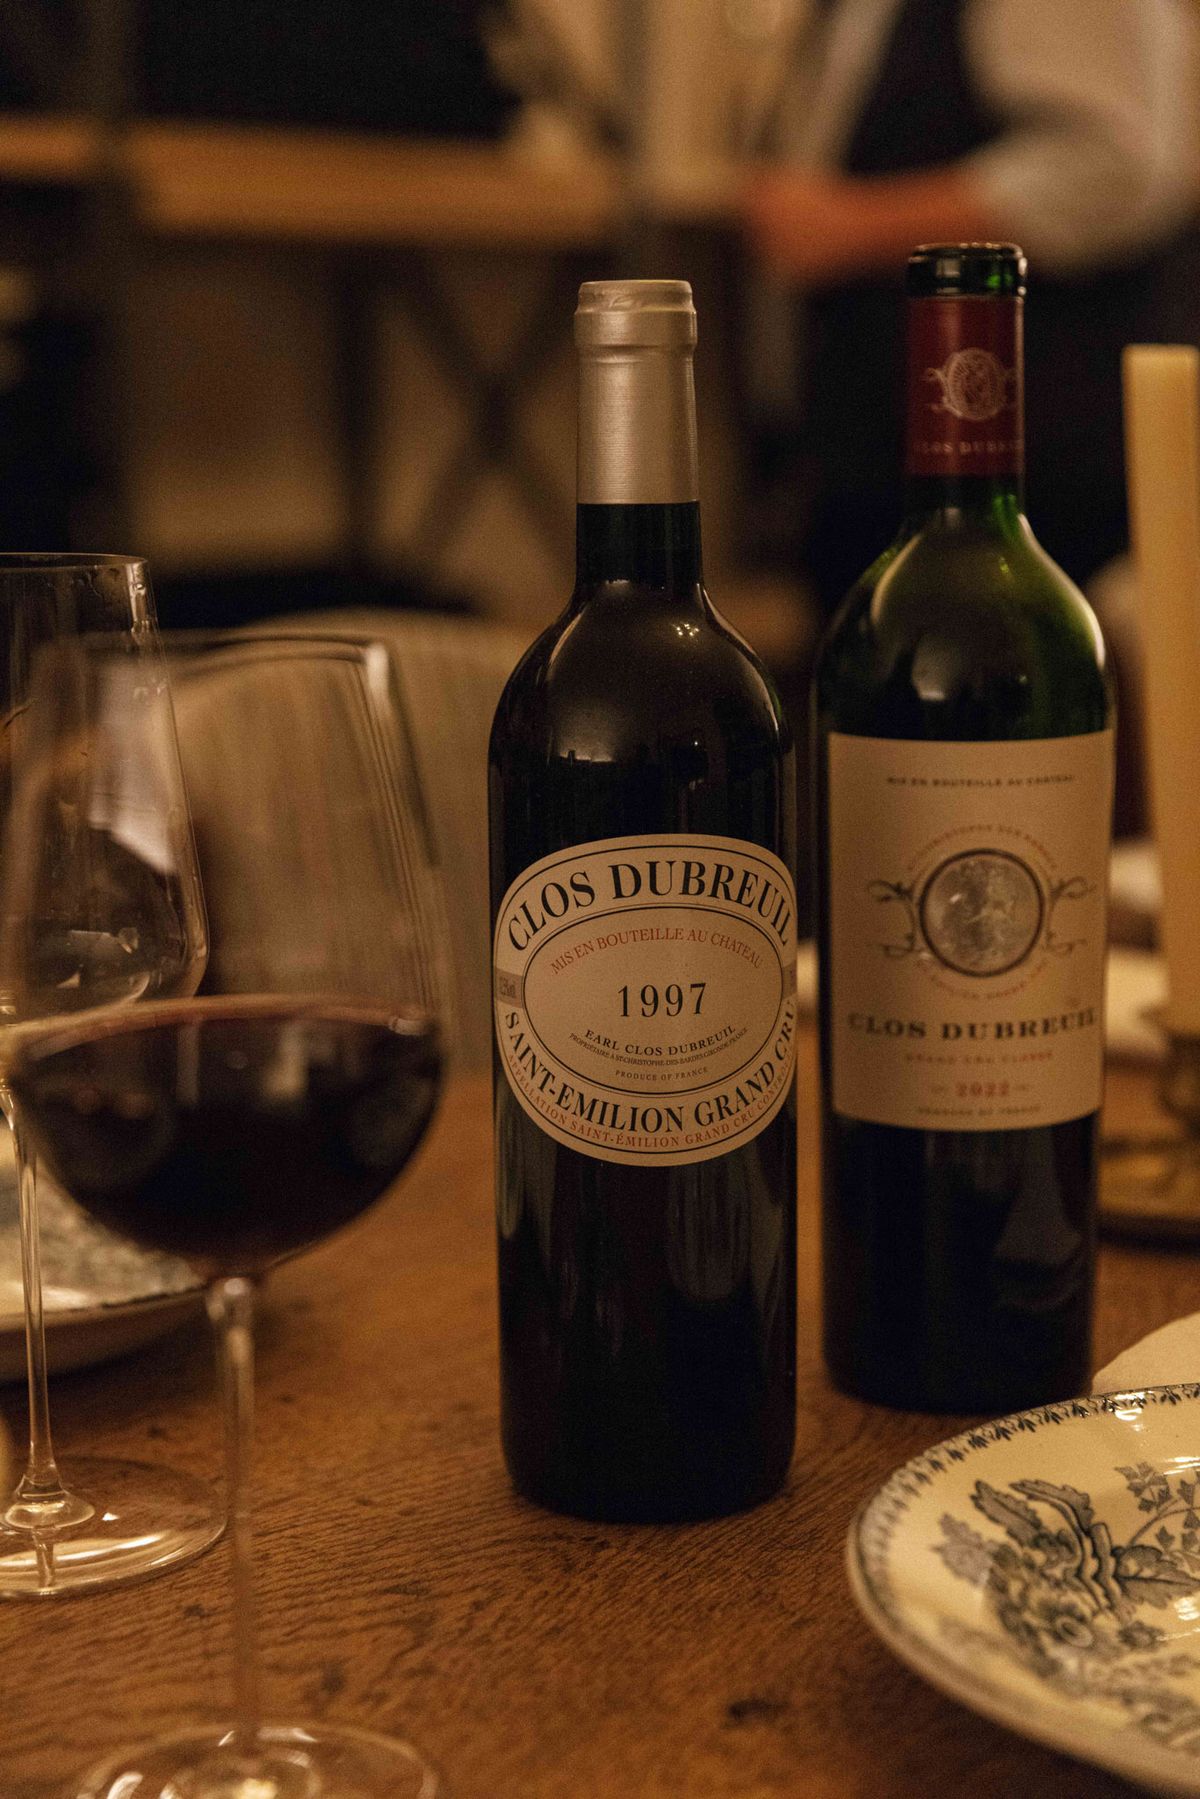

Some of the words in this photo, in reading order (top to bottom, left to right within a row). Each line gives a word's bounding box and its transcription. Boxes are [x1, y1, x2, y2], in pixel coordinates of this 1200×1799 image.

[508, 871, 596, 951] CLOS
[608, 860, 792, 946] DUBREUIL
[550, 950, 575, 976] MIS
[574, 941, 596, 959] EN
[596, 927, 685, 950] BOUTEILLE
[687, 928, 708, 943] AU
[710, 932, 764, 969] CHATEAU
[618, 982, 707, 1018] 1997
[584, 1029, 620, 1051] EARL
[624, 1044, 663, 1057] CLOS
[668, 1025, 736, 1056] DUBREUIL
[848, 1012, 927, 1039] CLOS
[505, 1011, 685, 1133] SAINT-EMILION
[694, 1061, 775, 1127] GRAND
[615, 1069, 658, 1081] PRODUCE
[660, 1072, 672, 1081] OF
[675, 1066, 709, 1080] FRANCE
[508, 1054, 567, 1125] APPELLATION
[685, 1123, 730, 1144] GRAND
[734, 1110, 753, 1128] CRU
